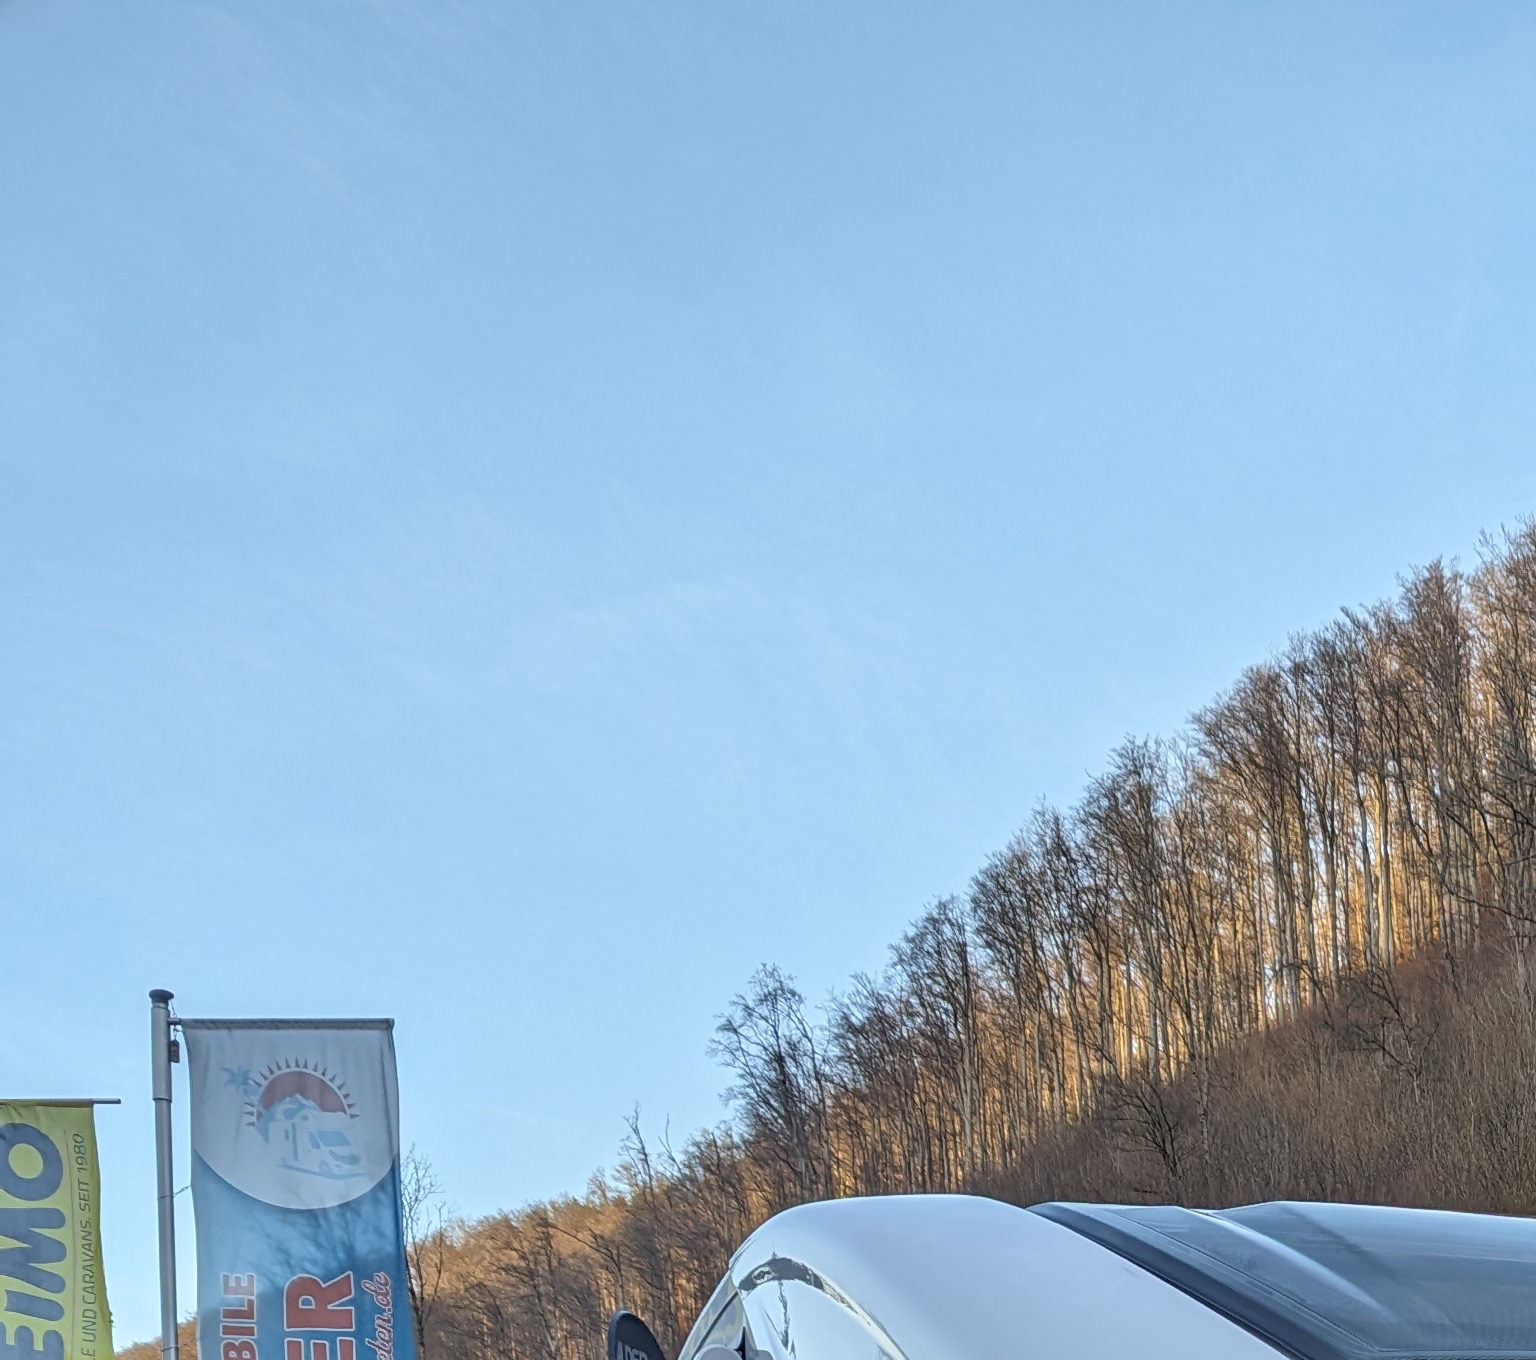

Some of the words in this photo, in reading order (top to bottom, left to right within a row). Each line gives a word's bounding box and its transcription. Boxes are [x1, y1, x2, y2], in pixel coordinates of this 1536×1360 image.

[77, 1178, 91, 1212] SEIT
[79, 1217, 97, 1304] CARAVANS.
[81, 1308, 97, 1343] UND
